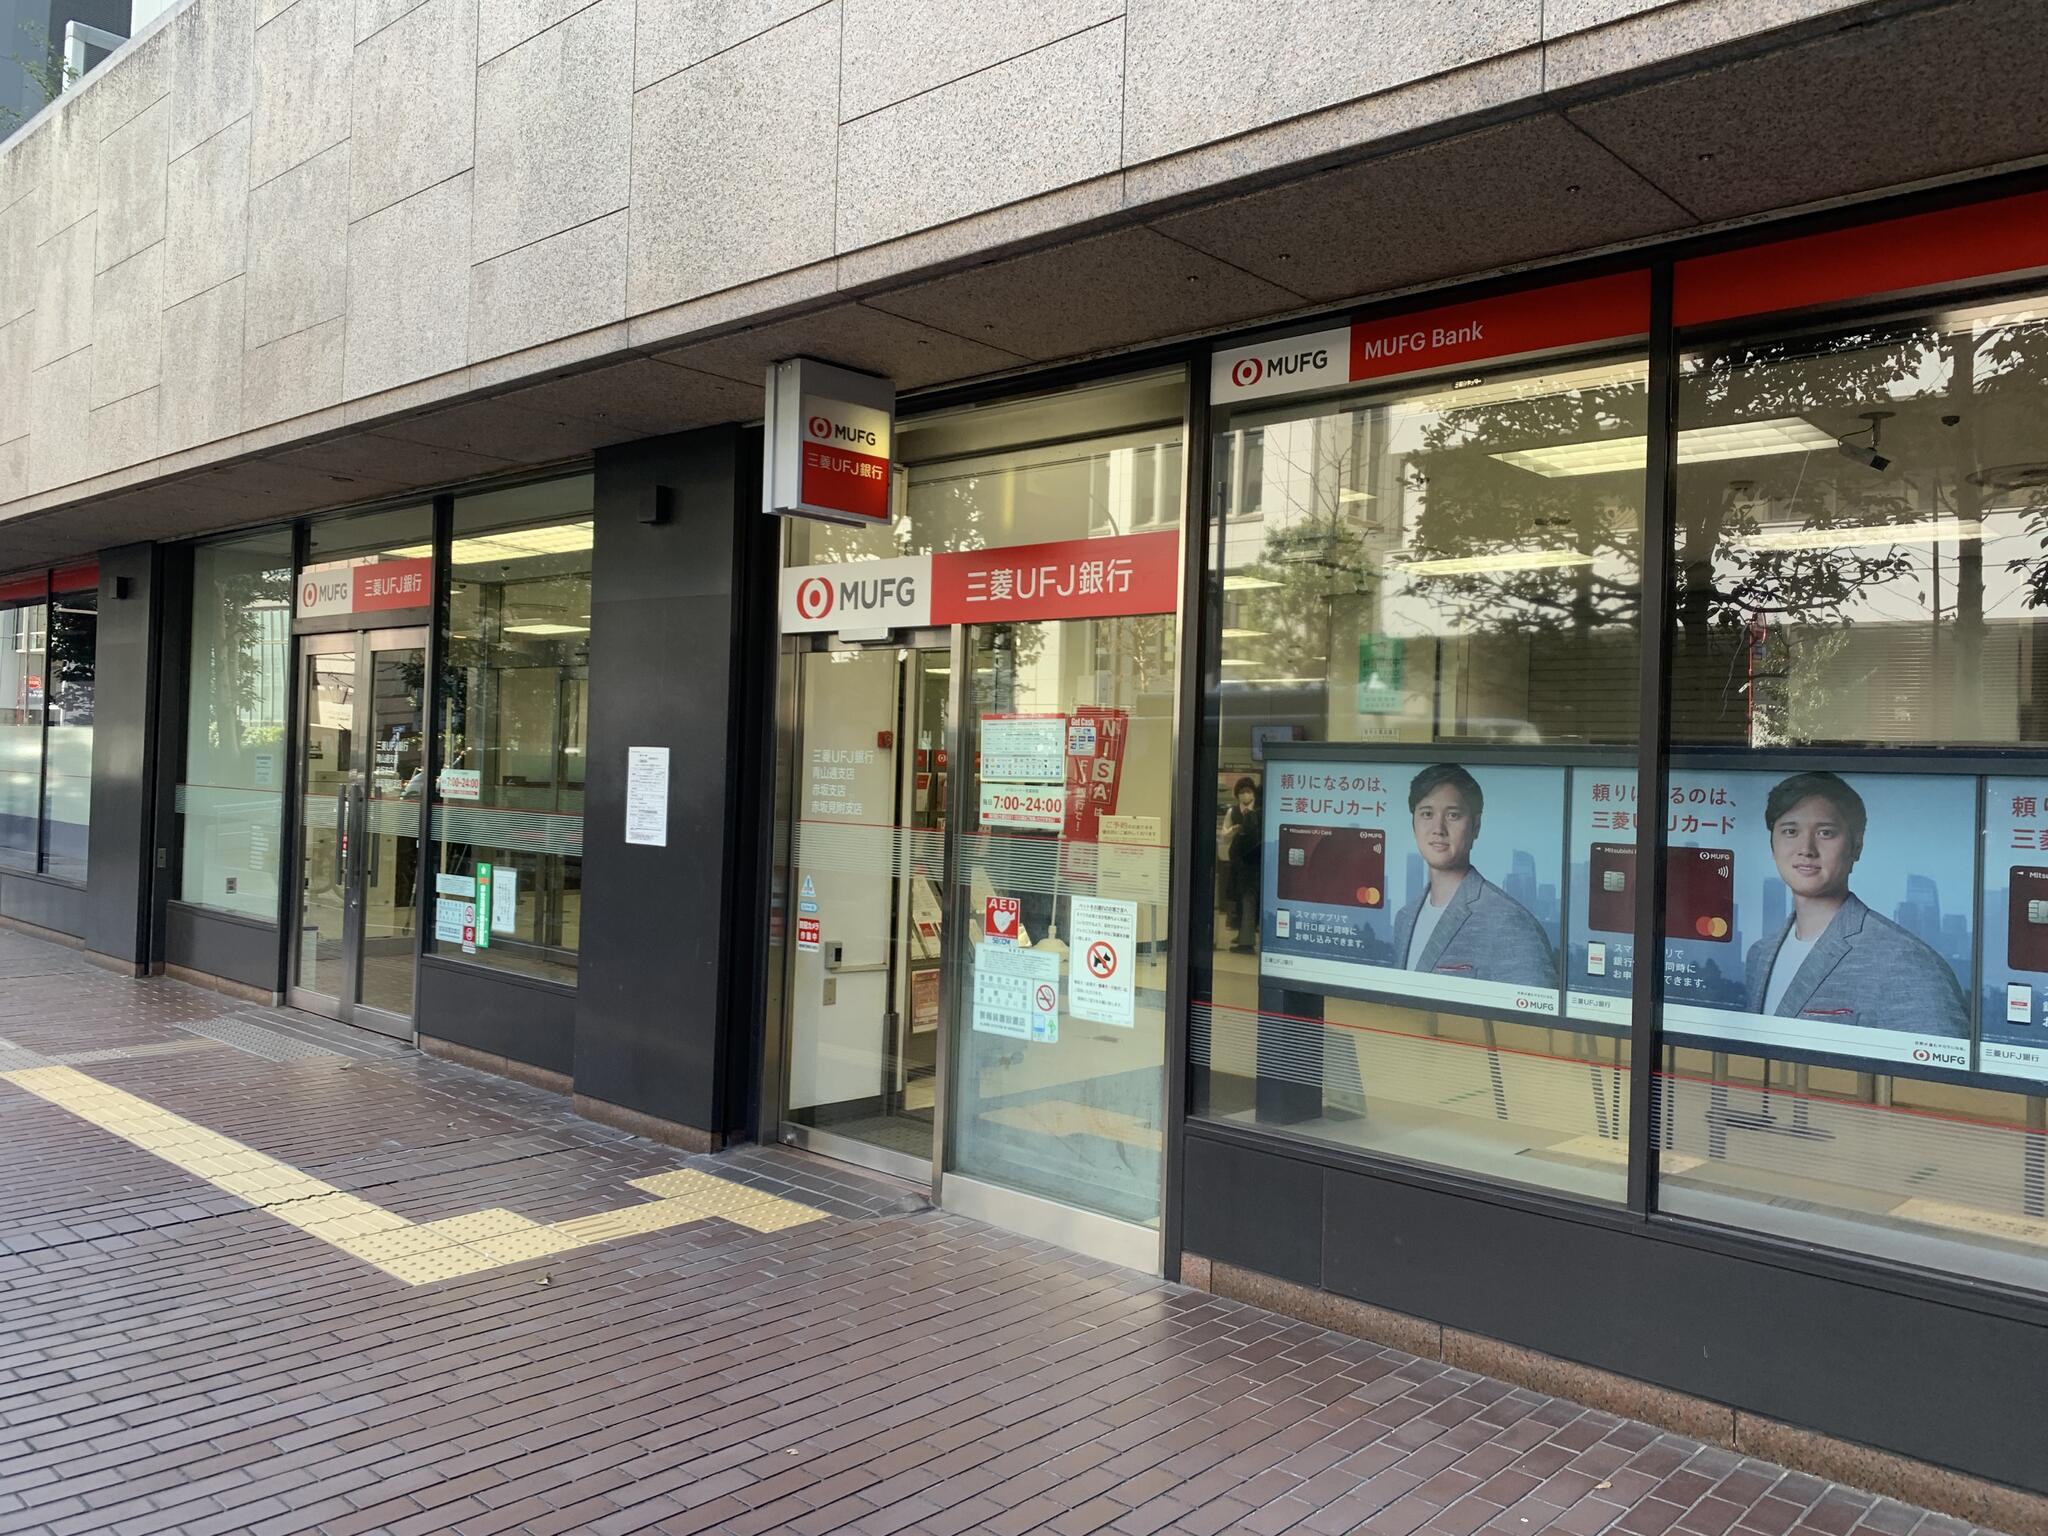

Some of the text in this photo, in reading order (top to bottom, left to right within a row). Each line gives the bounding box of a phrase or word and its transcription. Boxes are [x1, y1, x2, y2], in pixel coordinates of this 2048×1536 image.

[1364, 321, 1484, 361] MUFG Bank
[1267, 349, 1329, 378] MUFG
[834, 423, 876, 447] MUFG
[807, 452, 884, 481] 三菱UFJ銀行
[364, 573, 422, 597] 三菱UFJ銀行
[966, 558, 1134, 603] 三菱UFJ銀行
[318, 582, 348, 602] MUFG
[839, 576, 915, 611] MUFG
[812, 749, 874, 764] 三菱UFJ銀行
[1280, 774, 1388, 793] 頼りになるのは、
[1592, 783, 1737, 807] 頼りるのは、
[1280, 797, 1387, 817] 三菱UFJカード
[1592, 811, 1736, 835] 三菱Jカード
[989, 898, 1017, 911] AED
[1295, 910, 1348, 924] スマホアプリで
[1614, 944, 1684, 960] スマリで
[1613, 957, 1697, 974] 銀行同時に
[1613, 970, 1707, 988] お申できます。
[1530, 1001, 1554, 1011] MUFG
[1932, 1053, 1966, 1065] MUFG
[1985, 1048, 2039, 1063] 三菱UFJ銀行
